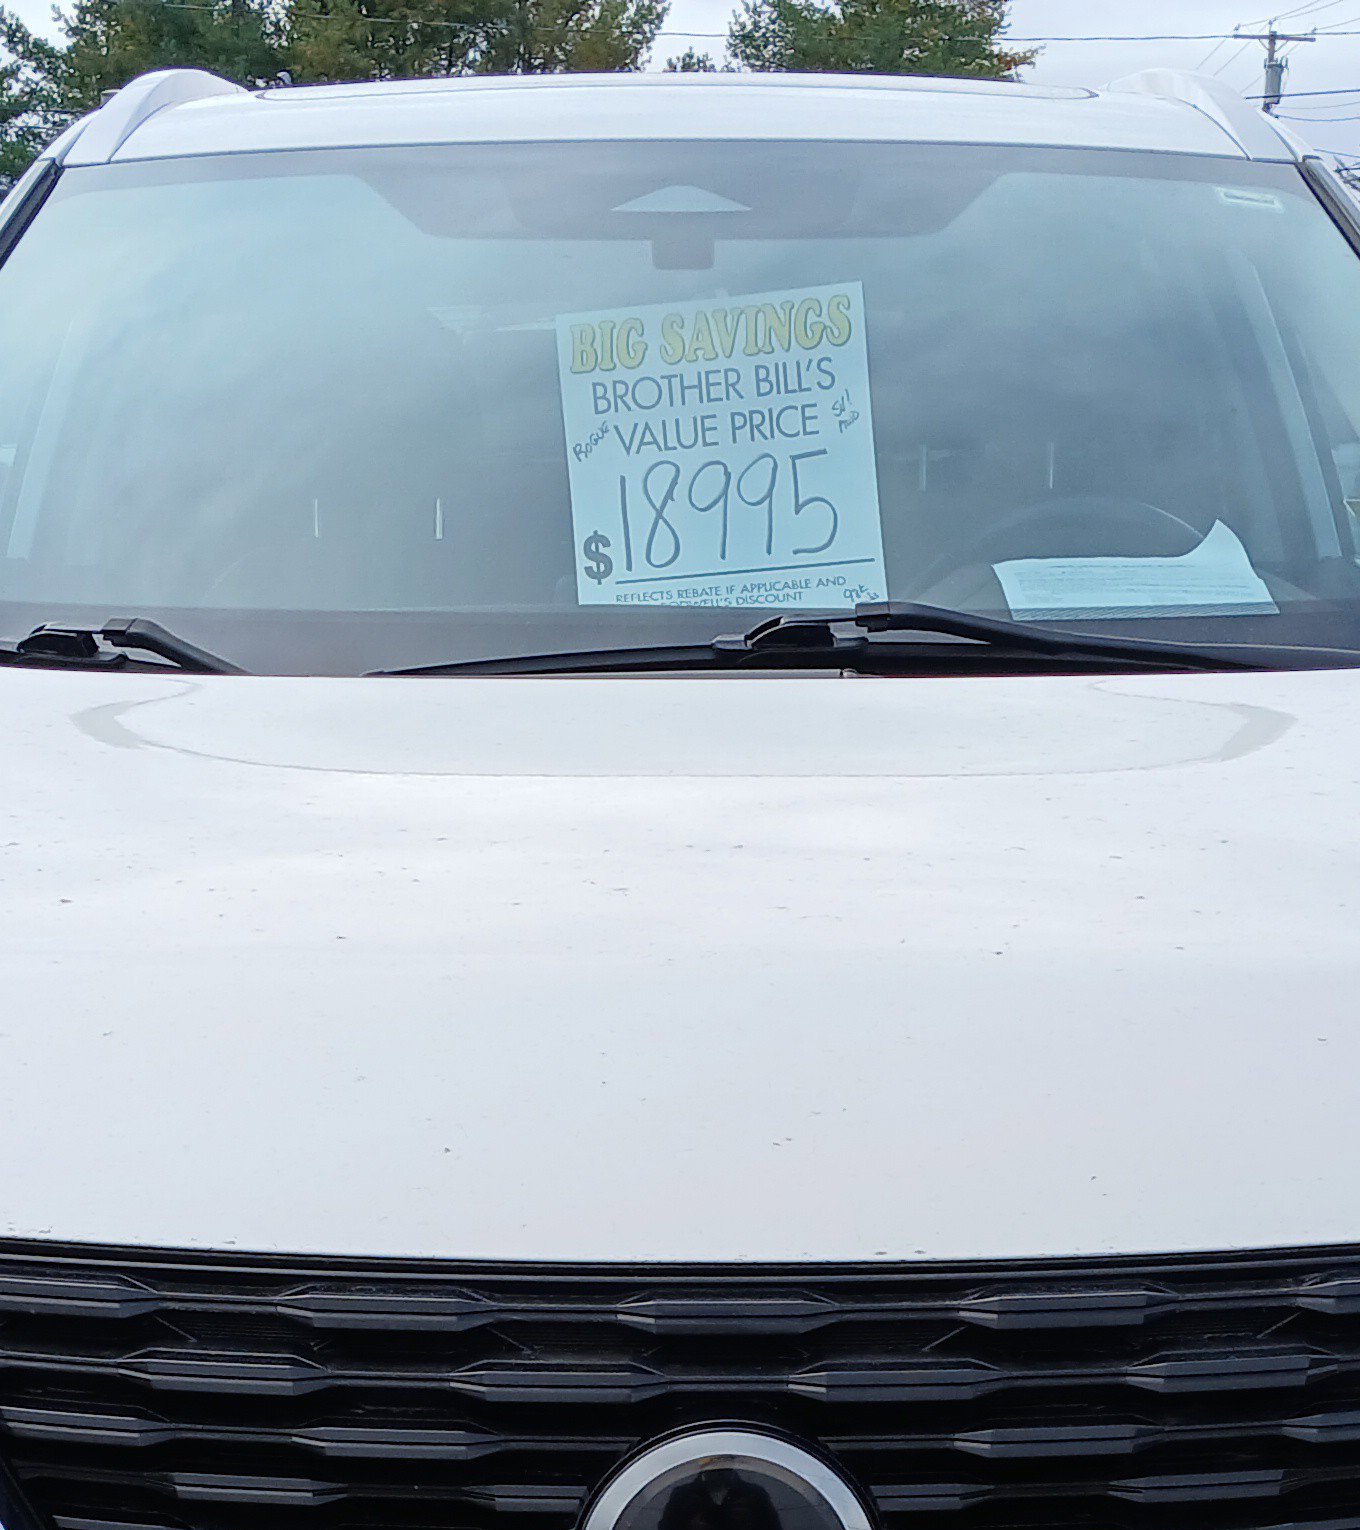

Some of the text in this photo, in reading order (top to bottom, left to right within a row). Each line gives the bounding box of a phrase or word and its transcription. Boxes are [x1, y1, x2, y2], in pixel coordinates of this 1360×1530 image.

[570, 294, 852, 374] BIG SAVINGS
[591, 356, 837, 416] BROTHER BILL'S
[614, 403, 820, 456] VALUE PRICE
[615, 575, 847, 603] REFLECTS REBATE IF APPLICABLE AND
[735, 591, 804, 606] DISCOUNT
